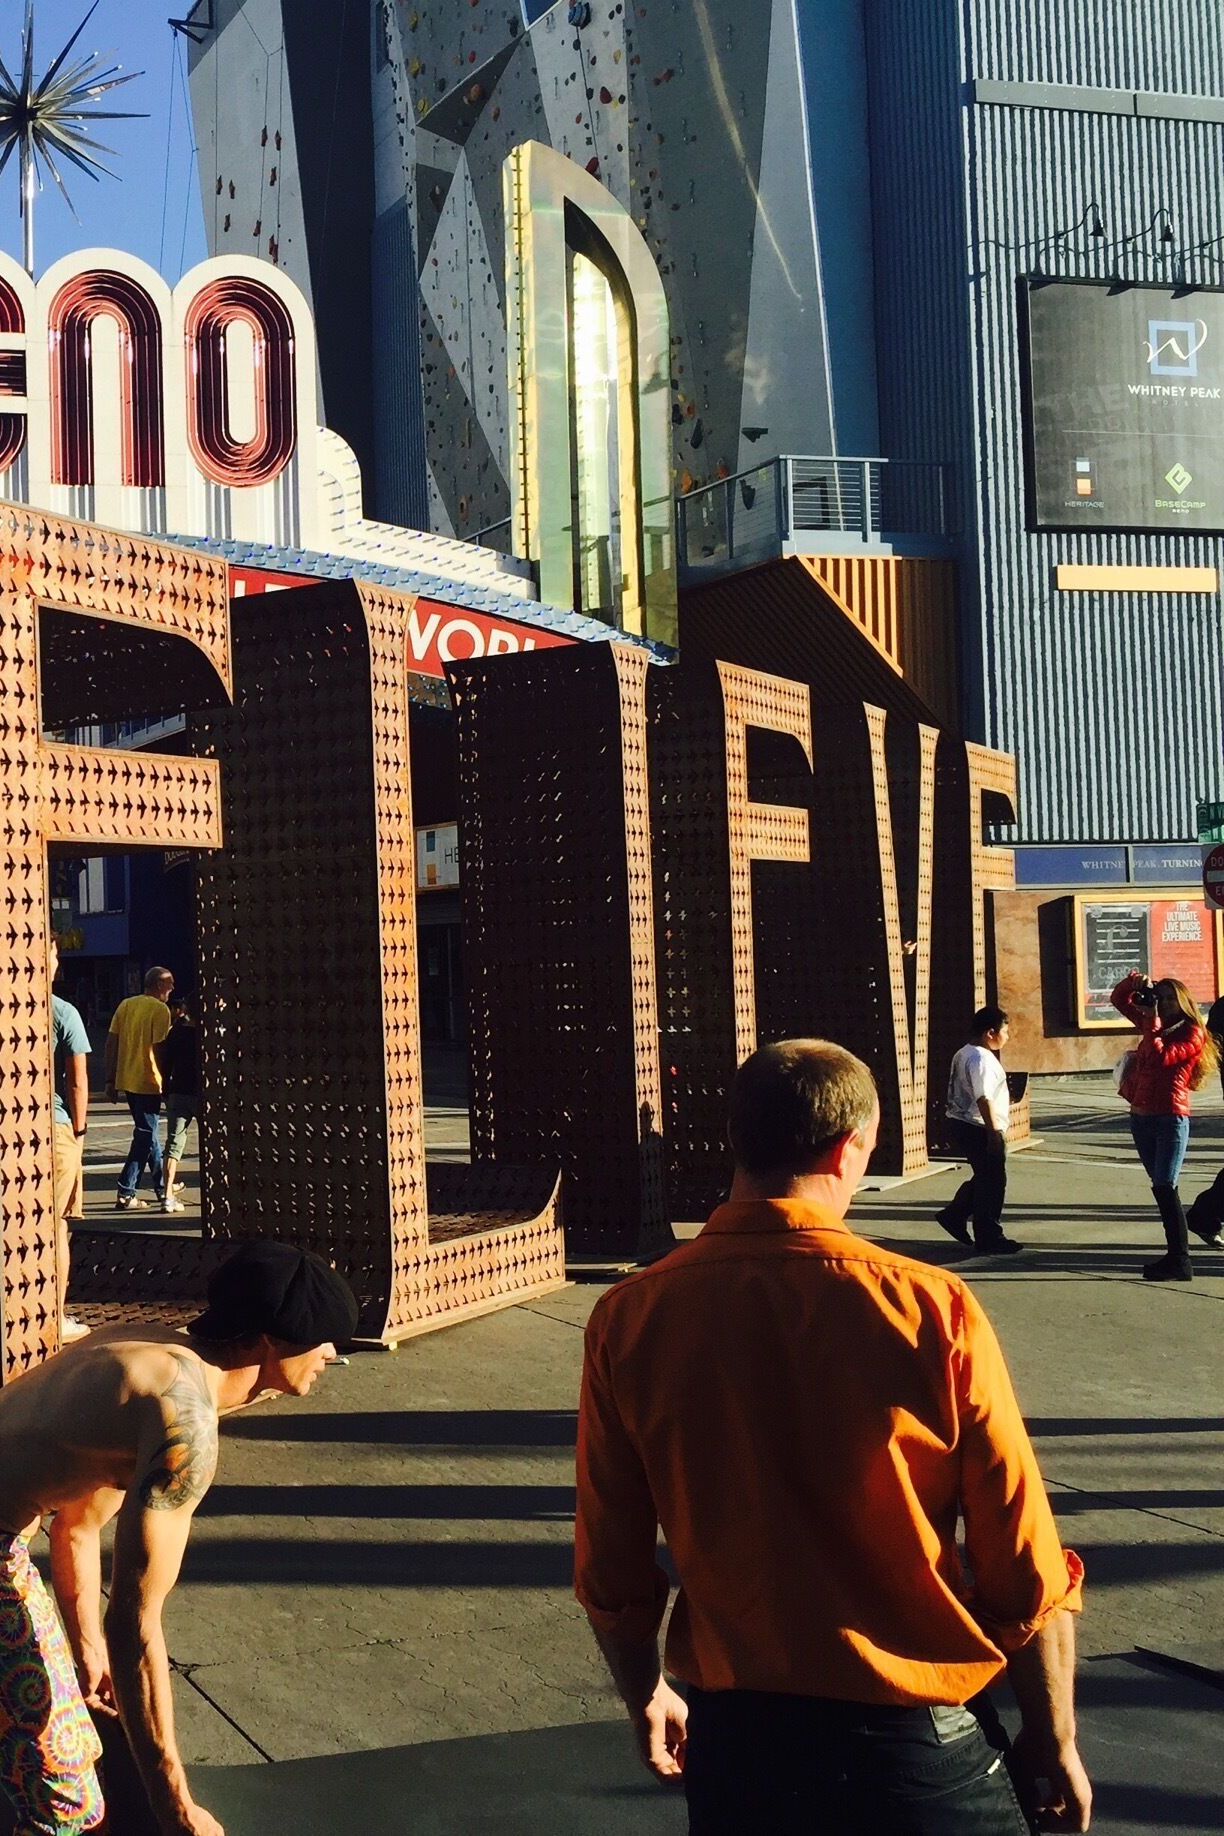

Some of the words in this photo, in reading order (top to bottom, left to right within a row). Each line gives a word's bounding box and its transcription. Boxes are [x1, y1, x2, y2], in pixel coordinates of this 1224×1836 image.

[1128, 384, 1186, 397] WHITNEY
[1190, 387, 1221, 399] PEAK
[1064, 500, 1104, 509] HERITAGE
[1161, 858, 1203, 869] TURNIN
[1166, 911, 1200, 922] ULTIMATE
[1164, 921, 1179, 931] LIVE
[1180, 921, 1201, 931] MUSIC
[1161, 931, 1203, 942] EXPERIENCE
